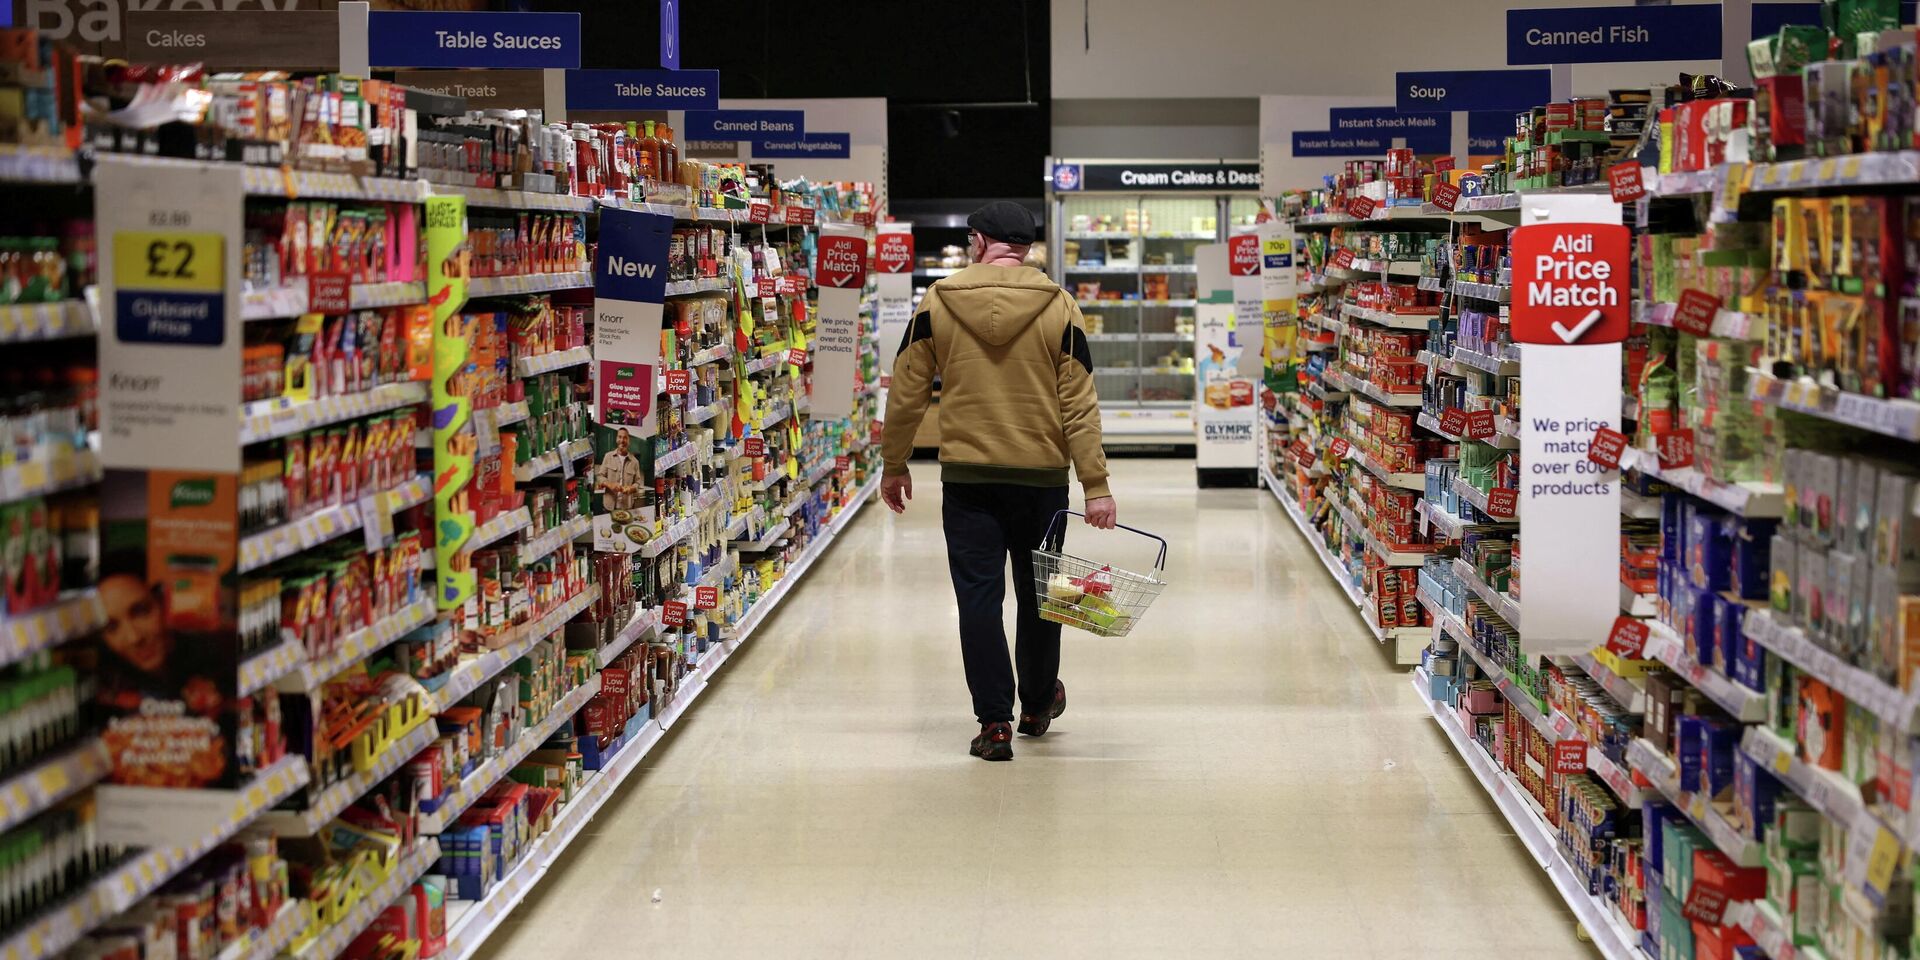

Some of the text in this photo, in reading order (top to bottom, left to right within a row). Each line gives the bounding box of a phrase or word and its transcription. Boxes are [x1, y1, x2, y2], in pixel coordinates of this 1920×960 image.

[146, 30, 206, 48] Cakes
[435, 31, 562, 50] Table Sauces
[1526, 26, 1649, 46] Canned Fish
[454, 84, 497, 98] Treats
[614, 84, 706, 98] Table Sauces
[1410, 85, 1446, 101] Soup
[714, 120, 794, 132] Canned Beans
[1339, 117, 1436, 128] Instant Snack Meals
[764, 141, 842, 152] Canned Vegetables
[1300, 139, 1380, 148] Instant Snack Meals
[1468, 138, 1496, 150] Crisps
[1121, 170, 1168, 184] Cream
[1171, 170, 1214, 184] Cakes
[1216, 171, 1226, 184] &
[1615, 174, 1636, 186] Low
[1440, 189, 1453, 200] Low
[1614, 184, 1640, 198] Price
[1435, 195, 1453, 208] Price
[430, 202, 452, 216] JUST
[752, 214, 767, 222] Price
[834, 241, 852, 250] Aldi
[882, 244, 908, 253] Price
[1269, 241, 1286, 250] 70p
[1552, 234, 1593, 253] Aldi
[146, 240, 196, 279] £2
[827, 249, 858, 262] Price
[880, 253, 910, 261] Match
[1234, 255, 1259, 264] Matc
[607, 255, 657, 280] New
[823, 260, 860, 273] Match
[1536, 254, 1611, 280] Price
[315, 284, 343, 296] Low
[1528, 281, 1617, 306] Match
[312, 296, 347, 310] Price
[1684, 301, 1710, 320] Low
[599, 312, 624, 324] Knorr
[822, 318, 854, 327] We price
[1676, 314, 1708, 331] Price
[826, 326, 849, 334] match
[838, 336, 853, 344] 600
[819, 344, 852, 353] products
[624, 384, 640, 392] your
[624, 392, 641, 400] night
[1446, 414, 1462, 424] Low
[1472, 418, 1490, 427] Low
[1204, 424, 1252, 434] OLYMPIC
[1442, 422, 1461, 434] Price
[1471, 426, 1493, 436] Price
[1532, 418, 1610, 436] We price
[1598, 438, 1618, 452] Low
[1590, 448, 1618, 463] Price
[1532, 464, 1570, 474] over
[1532, 481, 1610, 498] products
[1494, 497, 1512, 506] Low
[1490, 504, 1513, 515] Price
[632, 562, 641, 570] HP
[664, 615, 684, 623] Price
[1618, 628, 1642, 644] Price
[1613, 636, 1641, 651] Match
[606, 678, 623, 686] Low
[604, 686, 625, 694] Price
[1560, 752, 1580, 760] Low
[1557, 760, 1584, 770] Price
[1696, 895, 1718, 909] Low
[1688, 902, 1718, 922] Price
